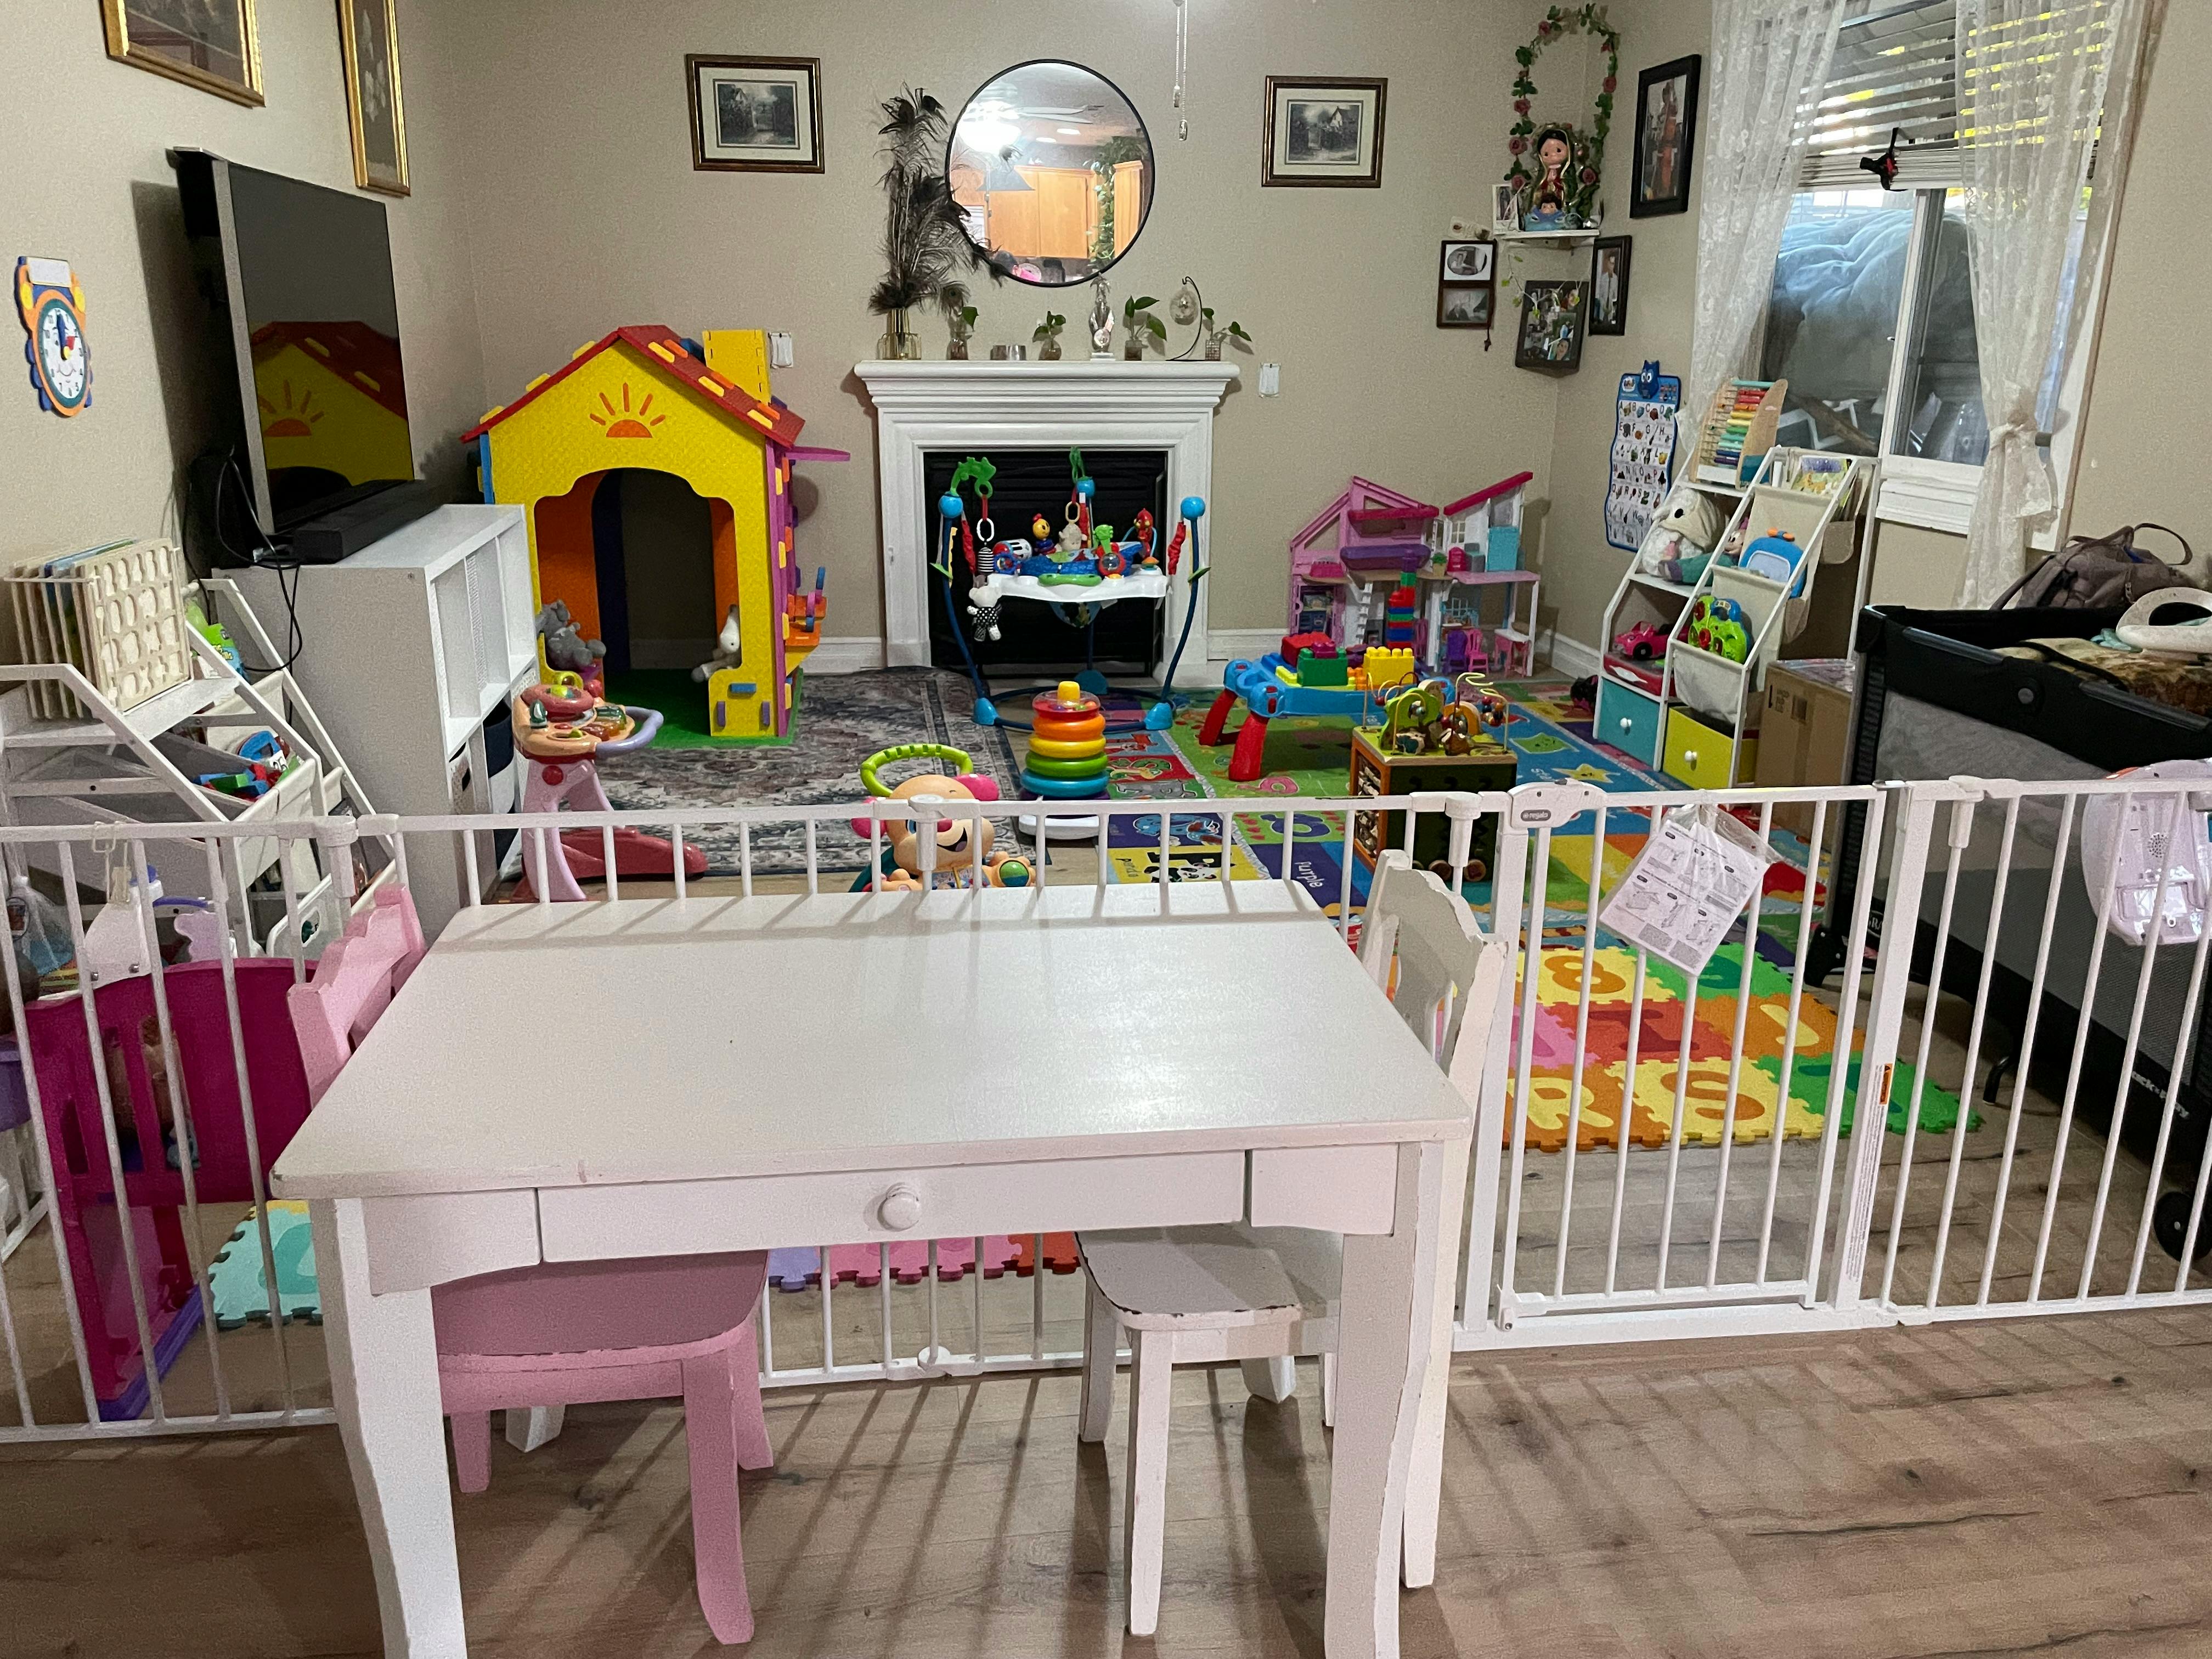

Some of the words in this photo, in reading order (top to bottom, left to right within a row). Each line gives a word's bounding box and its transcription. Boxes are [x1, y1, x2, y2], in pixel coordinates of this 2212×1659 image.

[1646, 403, 1650, 413] C
[1660, 427, 1664, 435] H
[1295, 861, 1325, 888] purple
[1544, 955, 1627, 994] 8
[1506, 1077, 1614, 1130] R
[1660, 1070, 1765, 1120] S
